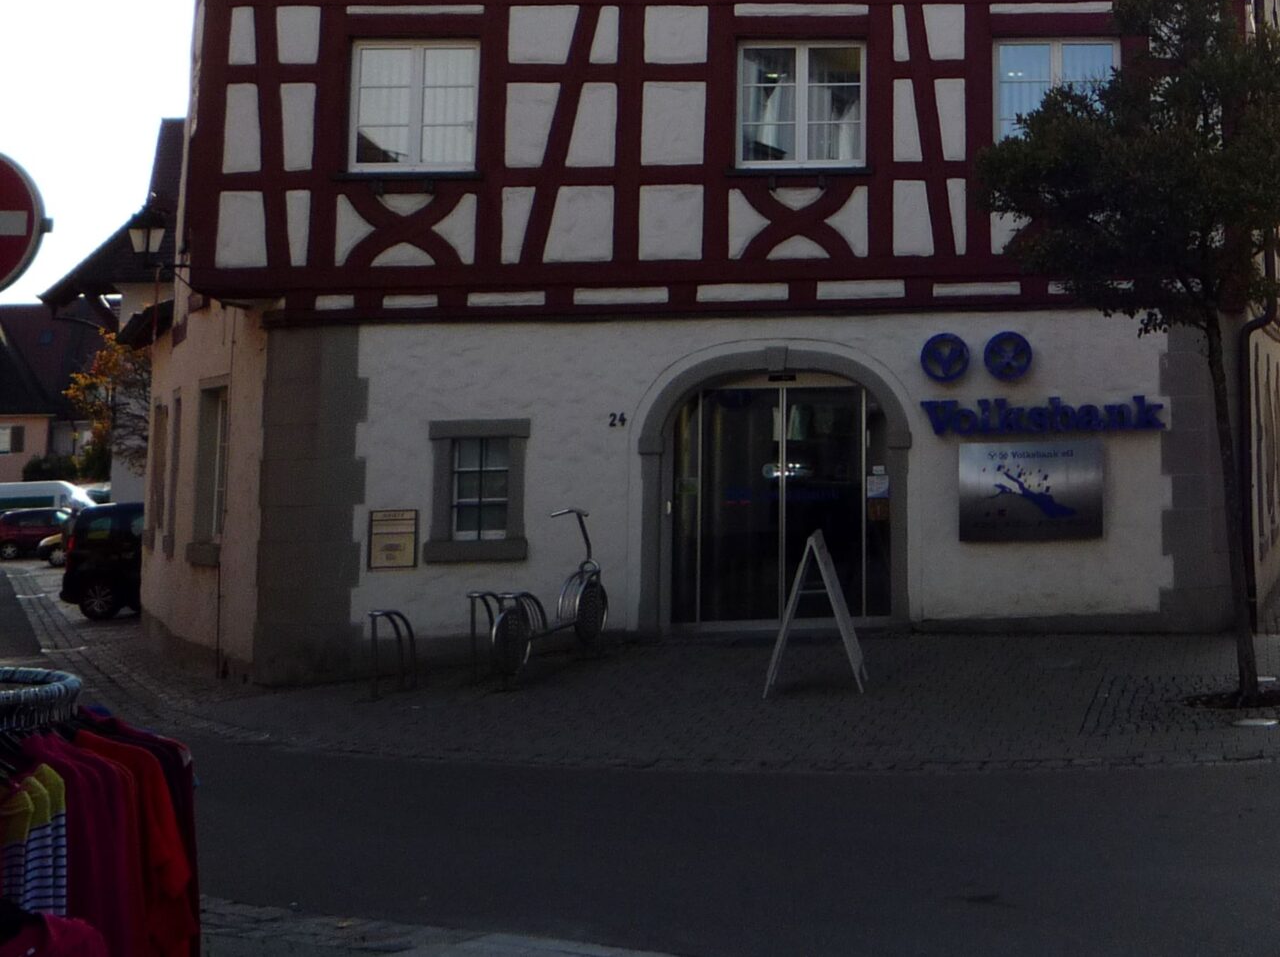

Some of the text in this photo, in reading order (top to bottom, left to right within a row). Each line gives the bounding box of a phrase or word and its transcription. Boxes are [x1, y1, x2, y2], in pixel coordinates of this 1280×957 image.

[609, 412, 627, 427] 24
[920, 395, 1167, 436] Volksbank
[1011, 450, 1058, 459] Volksbank
